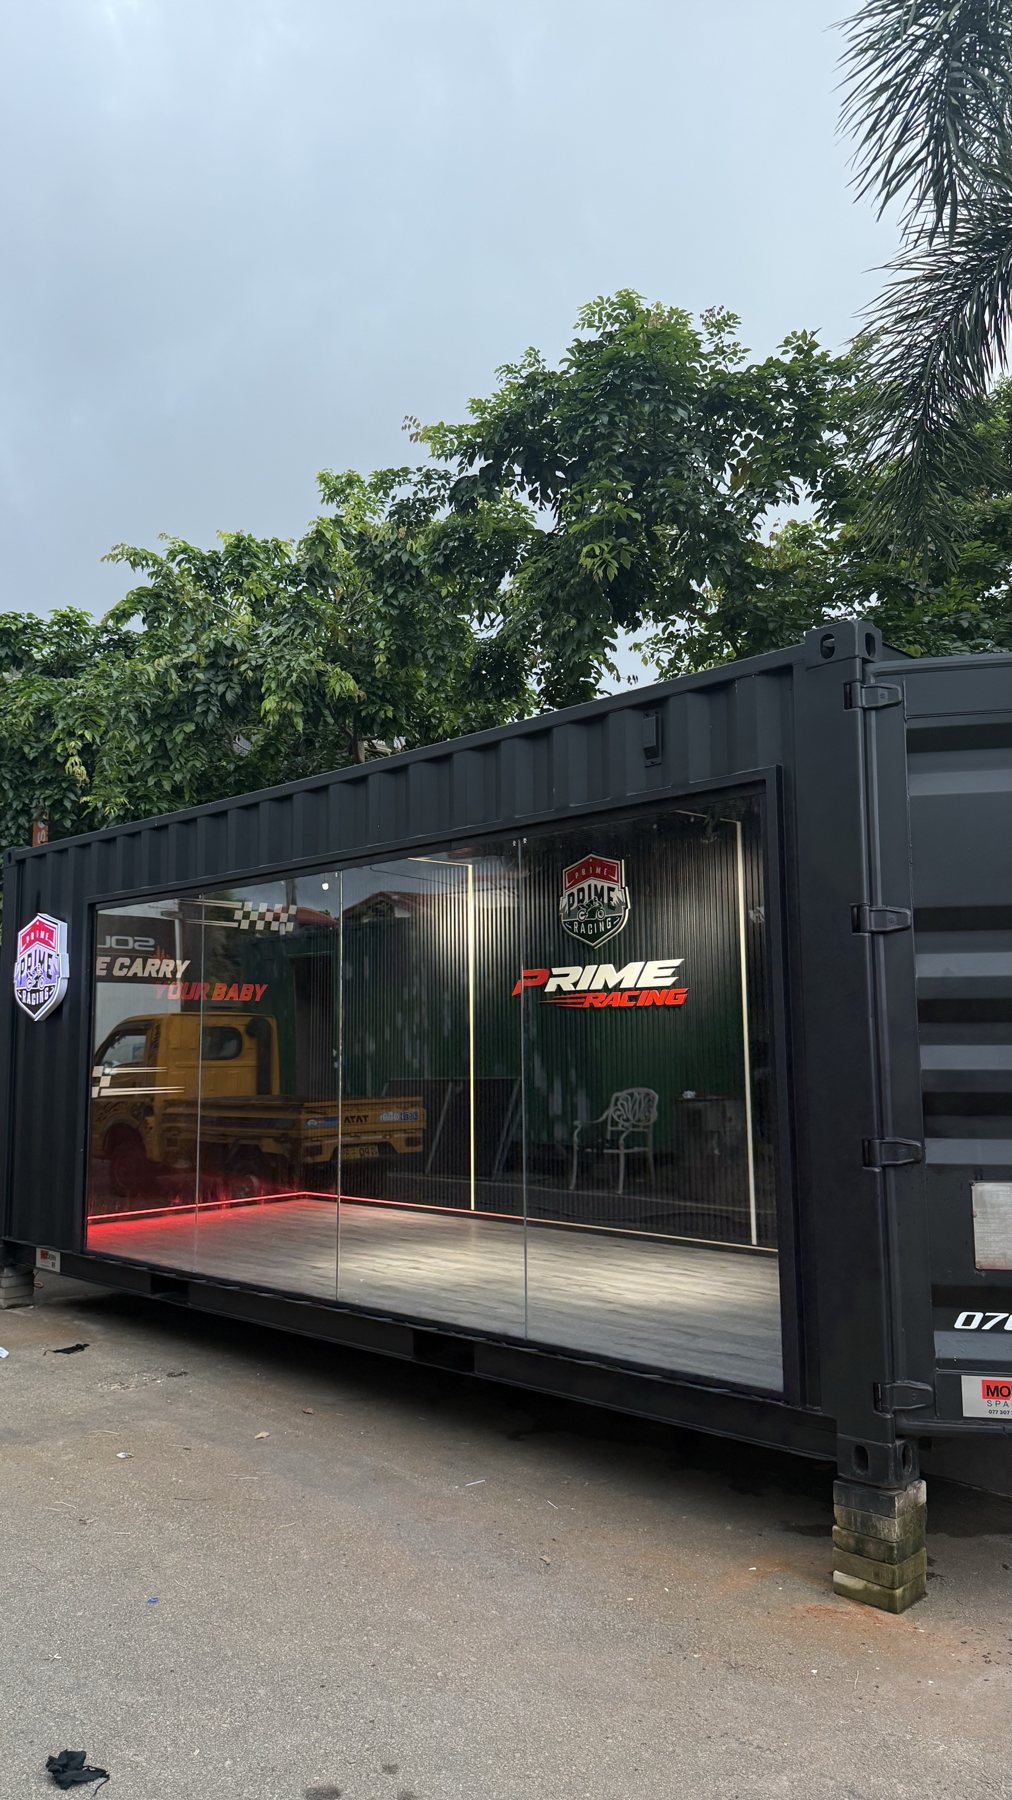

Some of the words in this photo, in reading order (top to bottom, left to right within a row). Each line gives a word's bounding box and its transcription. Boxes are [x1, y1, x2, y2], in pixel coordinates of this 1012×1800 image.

[575, 867, 607, 879] PRIME
[567, 884, 616, 916] PRIME
[573, 918, 612, 935] RACING
[26, 931, 49, 944] PRIME
[20, 949, 53, 986] PRIME
[112, 957, 191, 979] CARRY
[512, 958, 685, 997] PRIME
[22, 988, 49, 1006] RACING
[155, 981, 209, 1001] YOUR
[211, 983, 269, 1002] BABY
[582, 988, 690, 1008] RACING
[985, 1384, 1012, 1398] MO
